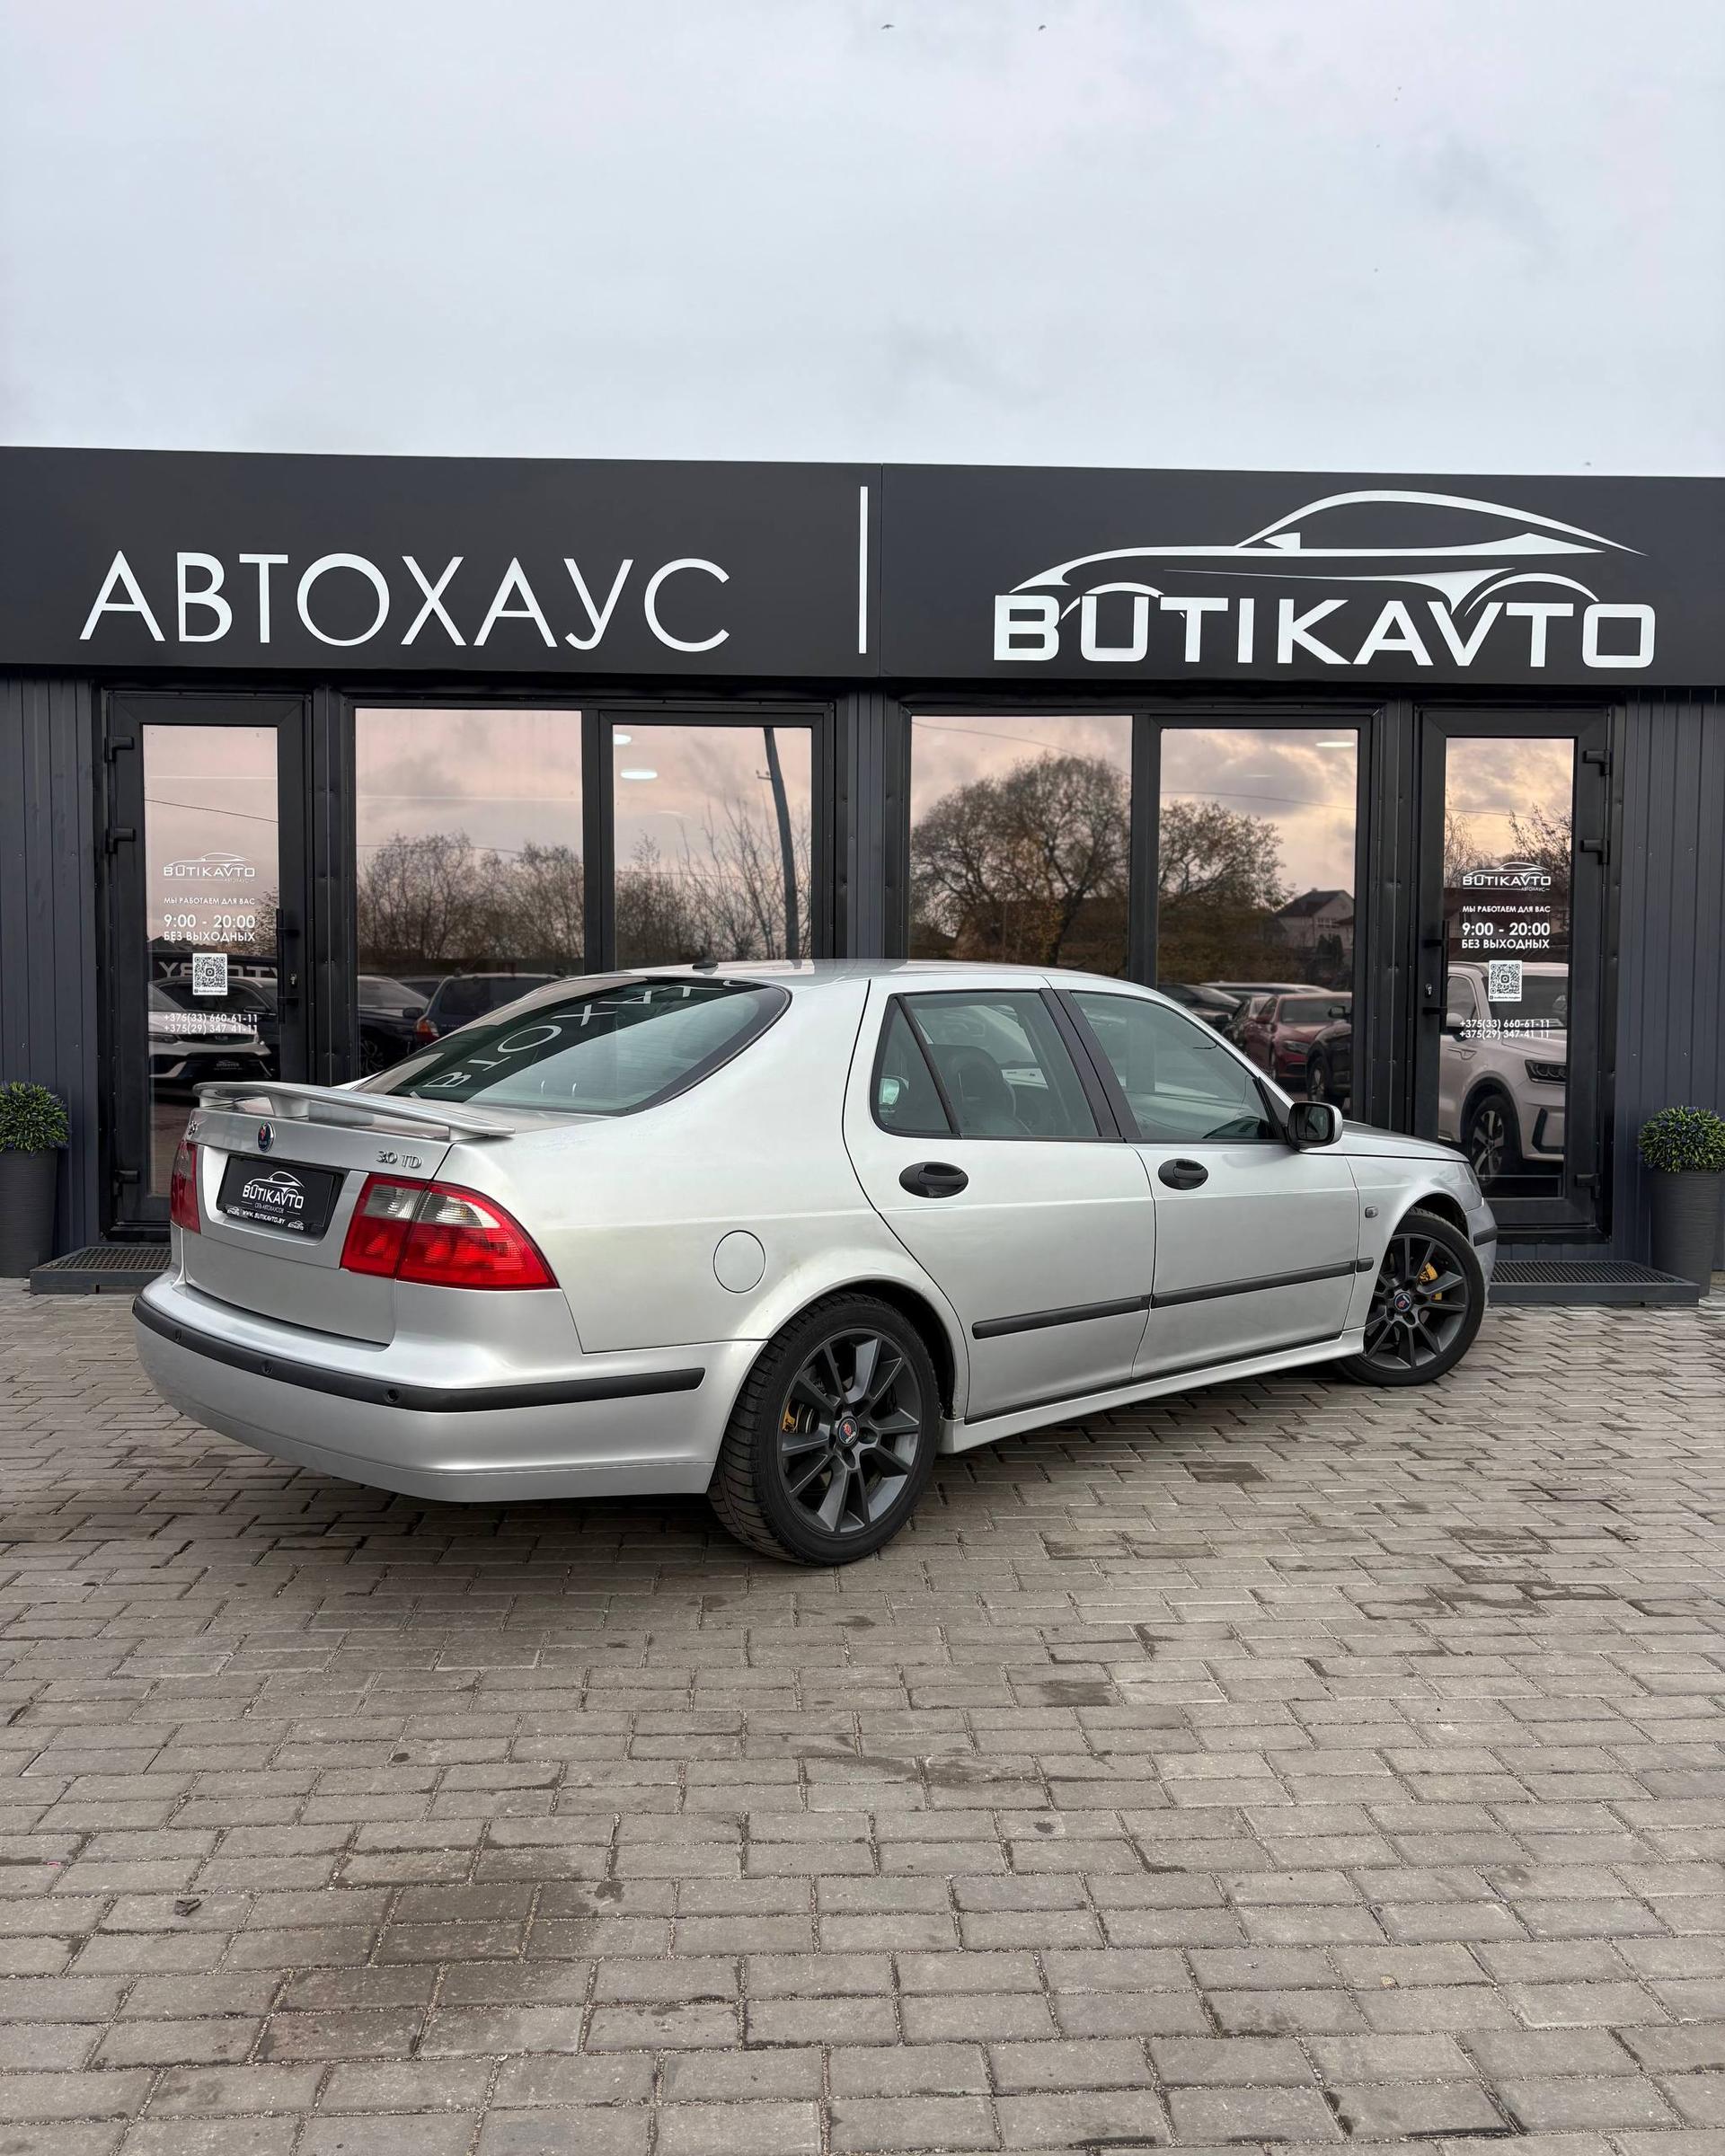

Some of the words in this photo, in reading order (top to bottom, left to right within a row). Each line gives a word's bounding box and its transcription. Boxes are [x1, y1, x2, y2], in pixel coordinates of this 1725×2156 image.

[79, 550, 730, 653] АВТОХАУС
[993, 594, 1656, 669] BUTIKAVTO
[164, 865, 255, 877] BUTIKAVTO
[1462, 875, 1552, 887] BUTIKAVTO
[221, 897, 237, 906] ДЛЯ
[239, 897, 255, 906] ВАС
[1517, 906, 1534, 914] ДЛЯ
[164, 914, 197, 927] 9:00
[213, 915, 256, 928] 20:00
[1462, 923, 1494, 936] 9:00
[1508, 923, 1551, 936] 20:00
[164, 932, 183, 941] БЕЗ
[186, 932, 255, 942] ВЫХОДНЫХ
[1462, 939, 1481, 949] БЕЗ
[1482, 939, 1550, 950] ВЫХОДНЫХ
[164, 1013, 207, 1024] +375(33)
[209, 1013, 258, 1022] 660-61-11
[1459, 1019, 1501, 1029] +375(33)
[1503, 1019, 1550, 1028] 660-61-11
[209, 1024, 258, 1033] 34741-11
[1459, 1029, 1501, 1039] +375(29)
[1503, 1029, 1550, 1038] 347-4111
[242, 1184, 305, 1209] BUTIKAVTO
